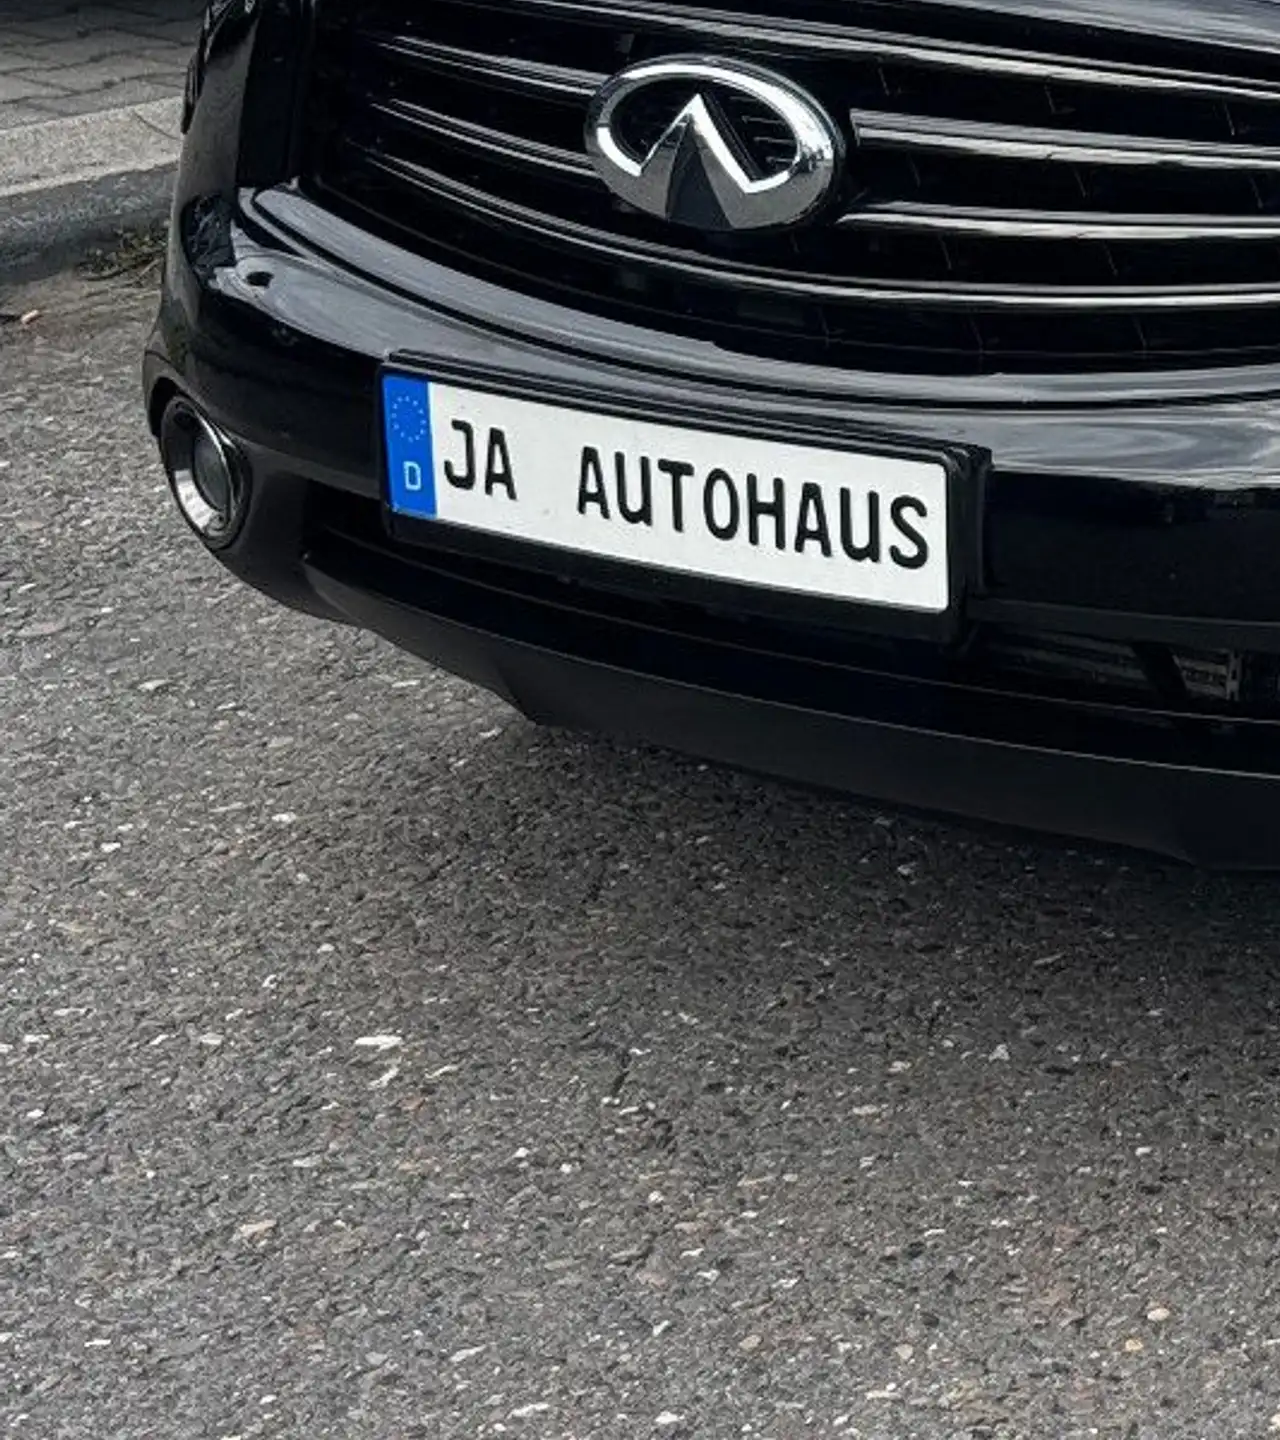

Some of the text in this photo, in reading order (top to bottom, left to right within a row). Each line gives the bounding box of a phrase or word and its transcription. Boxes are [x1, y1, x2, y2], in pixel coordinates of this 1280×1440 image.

[404, 419, 929, 570] D JA AUTOHAUS
